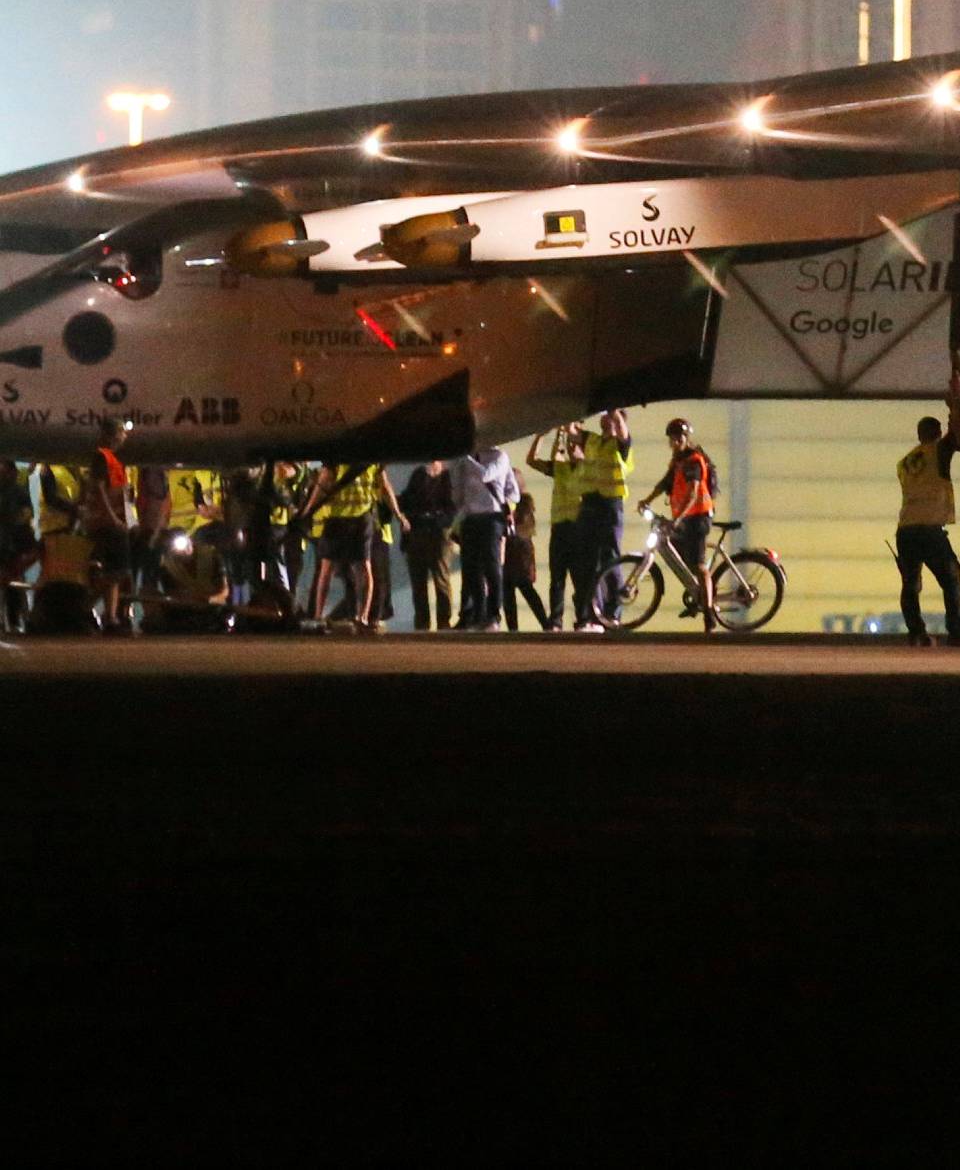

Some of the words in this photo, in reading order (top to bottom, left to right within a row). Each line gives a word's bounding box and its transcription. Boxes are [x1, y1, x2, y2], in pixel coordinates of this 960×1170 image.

[609, 226, 695, 249] SOLVAY
[790, 310, 894, 339] Google
[174, 397, 241, 425] ABB
[260, 407, 347, 426] OMEGA
